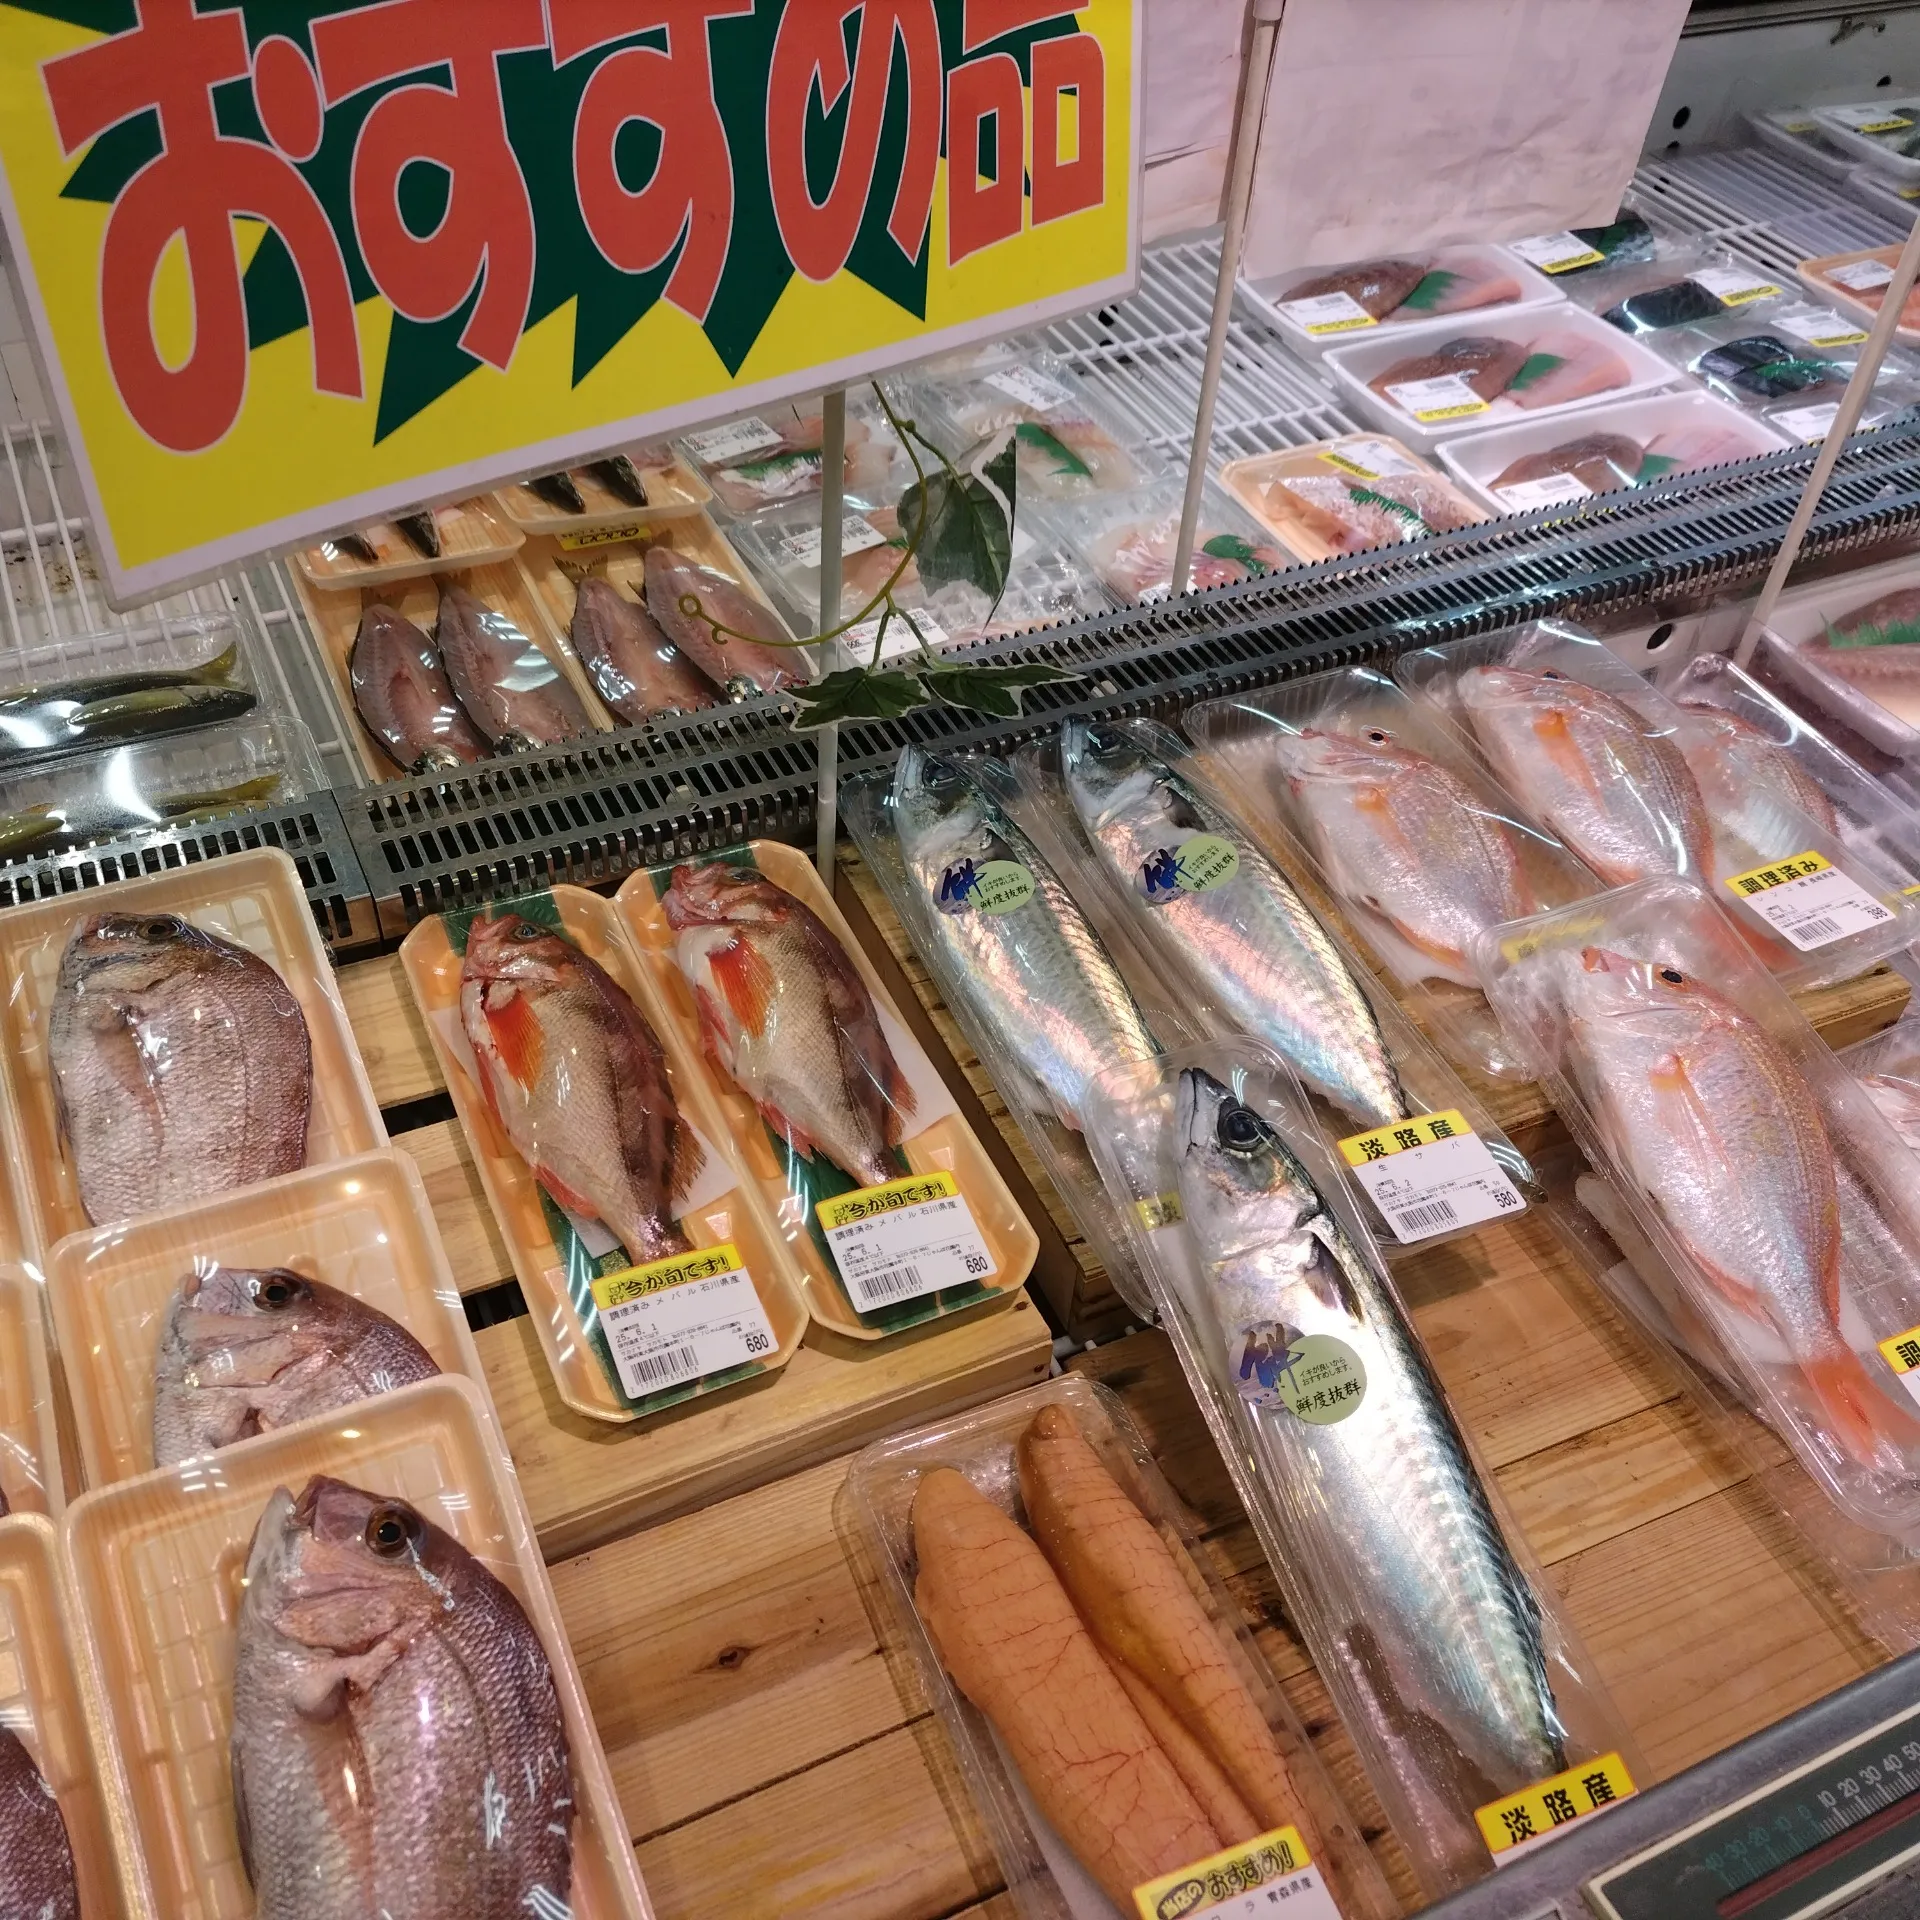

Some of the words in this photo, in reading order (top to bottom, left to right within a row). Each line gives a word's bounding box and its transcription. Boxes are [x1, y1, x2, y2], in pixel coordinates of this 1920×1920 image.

[42, 0, 1105, 454] おすすめ品
[1193, 852, 1235, 890] 鮮度抜群
[1738, 860, 1819, 894] 調理済み
[980, 883, 1030, 911] 鮮度抜群
[1867, 907, 1888, 920] 398
[1494, 1191, 1517, 1209] 580
[835, 1223, 874, 1241] 調理済み
[920, 1200, 958, 1216] 石川県産
[966, 1256, 988, 1274] 680
[609, 1301, 651, 1322] 調理済み
[700, 1274, 741, 1292] 石川県産
[746, 1334, 769, 1353] 680
[1300, 1356, 1346, 1377] イキが良いから
[1302, 1364, 1352, 1387] おすすめします。
[1296, 1378, 1362, 1414] 鮮度抜群
[1816, 1789, 1837, 1809] 10
[1837, 1777, 1860, 1798] 20
[1859, 1764, 1882, 1786] 30
[1883, 1753, 1903, 1773] 40
[1901, 1741, 1920, 1761] 50
[1500, 1771, 1617, 1845] 淡路産
[1266, 1876, 1315, 1904] 青森県産
